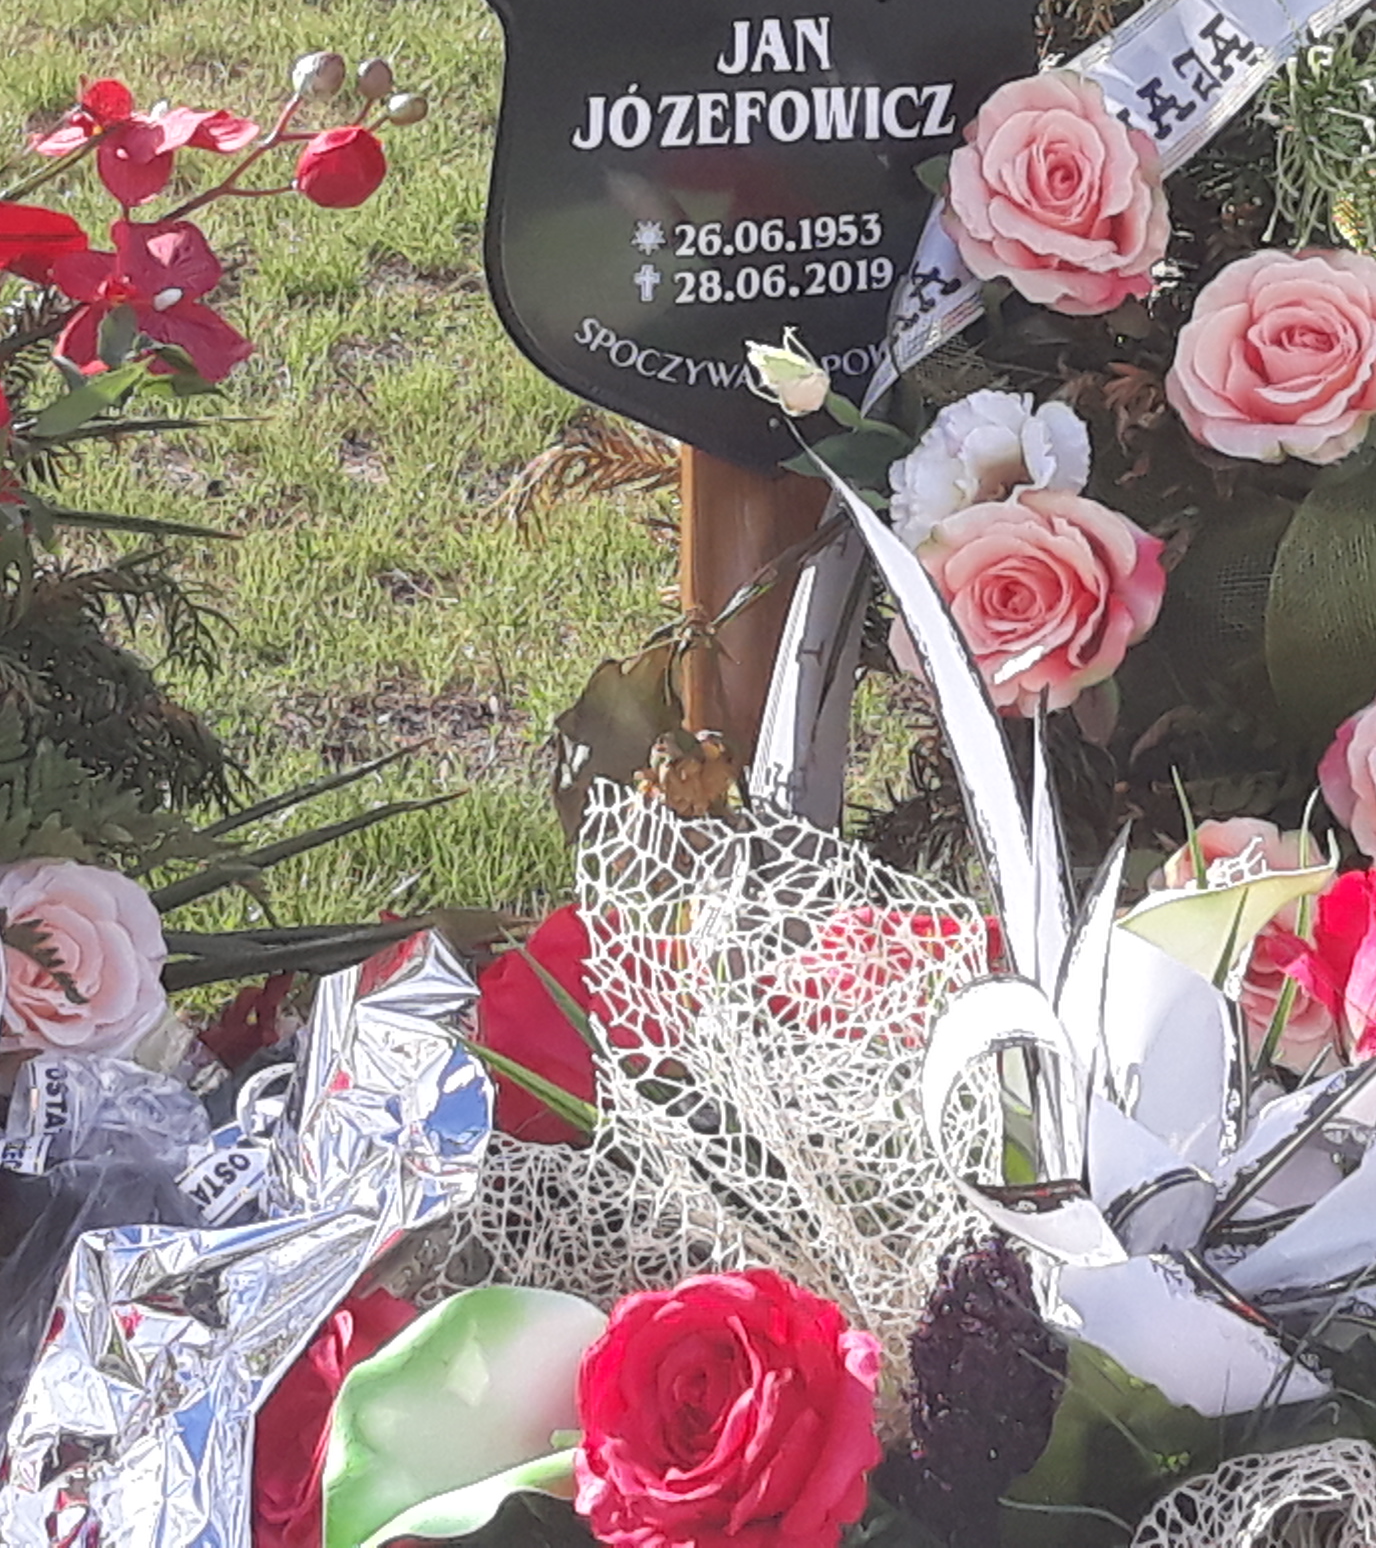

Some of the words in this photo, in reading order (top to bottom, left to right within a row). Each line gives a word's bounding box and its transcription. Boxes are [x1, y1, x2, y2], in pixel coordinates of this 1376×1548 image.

[716, 15, 832, 75] JAN
[570, 82, 957, 150] JÓZEFOWICZ
[673, 212, 883, 257] 26.06.1953
[673, 257, 895, 304] 28.06.2019
[573, 317, 753, 391] SPOCZYWA
